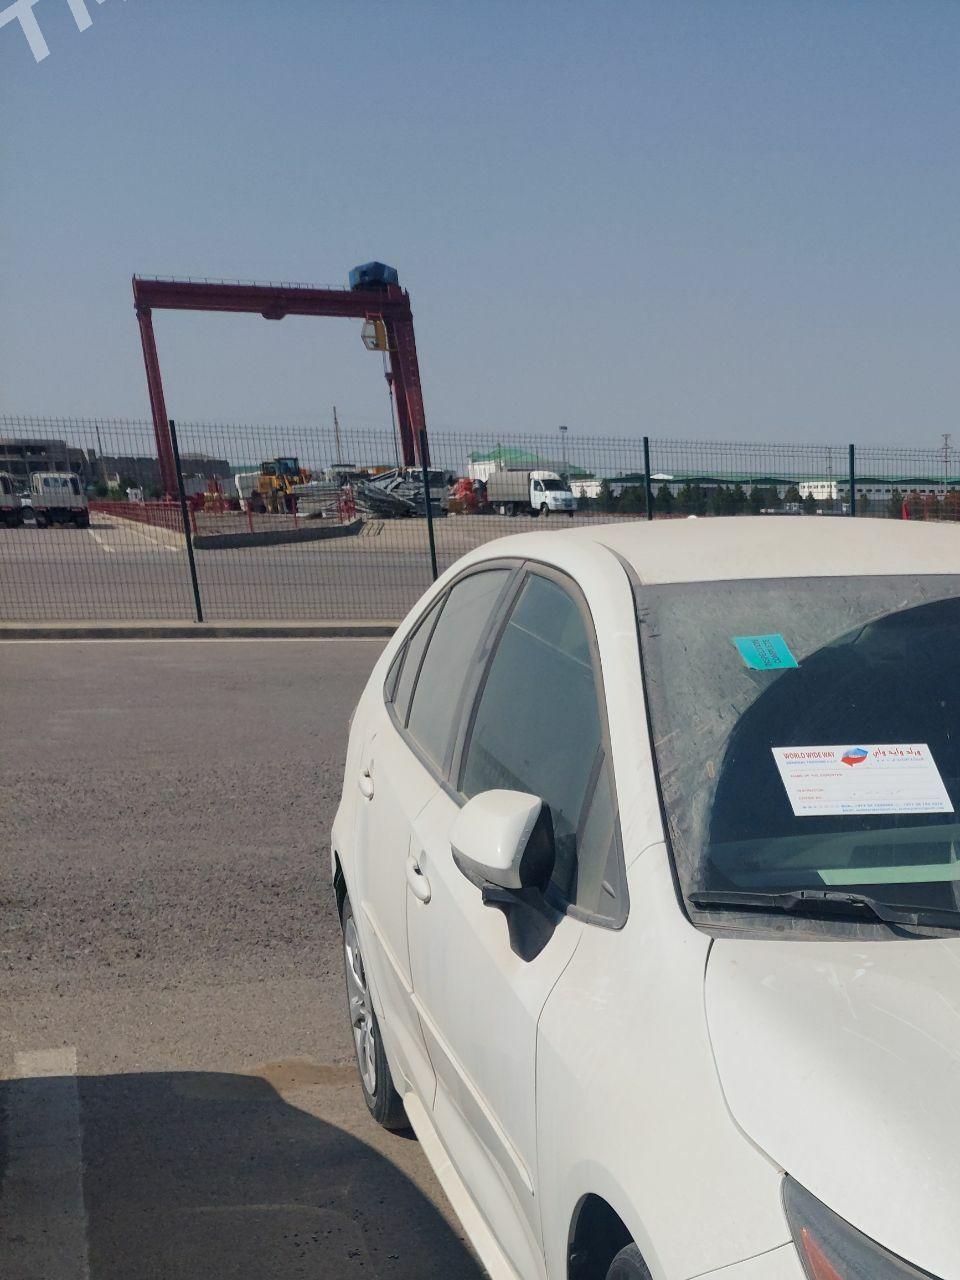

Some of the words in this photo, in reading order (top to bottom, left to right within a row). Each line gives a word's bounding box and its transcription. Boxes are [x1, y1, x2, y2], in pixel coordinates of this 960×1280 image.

[783, 752, 806, 760] WORLD
[806, 751, 821, 759] WIDE
[822, 751, 835, 759] WAY
